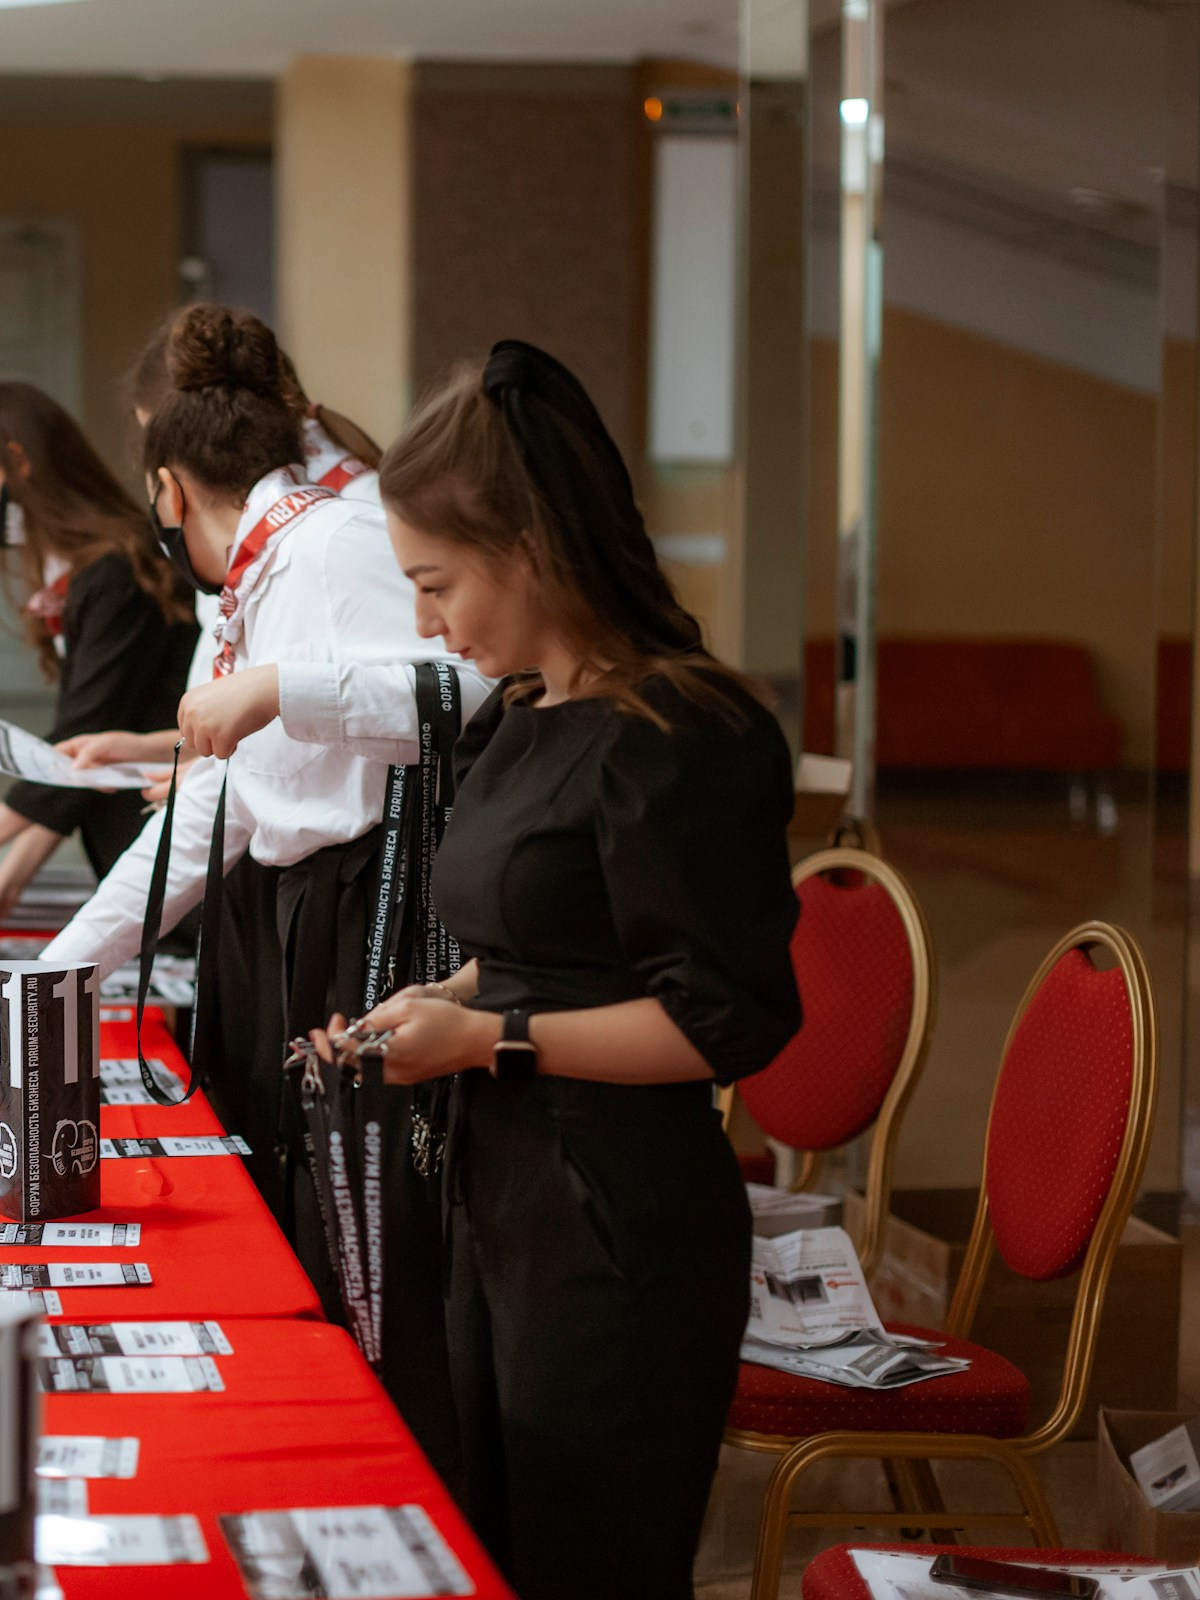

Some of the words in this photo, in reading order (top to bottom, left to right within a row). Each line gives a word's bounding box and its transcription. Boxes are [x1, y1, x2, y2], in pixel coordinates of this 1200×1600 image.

[439, 673, 453, 712] ФОРУМ
[382, 829, 398, 881] БИЗНЕСА
[370, 881, 391, 966] БЕЗОПАСНОСТЬ
[425, 930, 437, 982] АСНОСТЬ
[365, 967, 379, 1010] ФОРУМ
[27, 976, 39, 1068] FORUM-SECURITY.RU
[28, 1070, 40, 1111] БИЗНЕСА
[28, 1113, 40, 1180] БЕЗОПАСНОСТЬ
[329, 1131, 349, 1188] ФОРУМ
[364, 1121, 382, 1178] ФОРУМ
[29, 1181, 40, 1216] ФОРУМ
[333, 1188, 364, 1298] БЕЗОПАСНОСТЬ
[364, 1179, 383, 1291] БЕЗОПАСНОСТЬ
